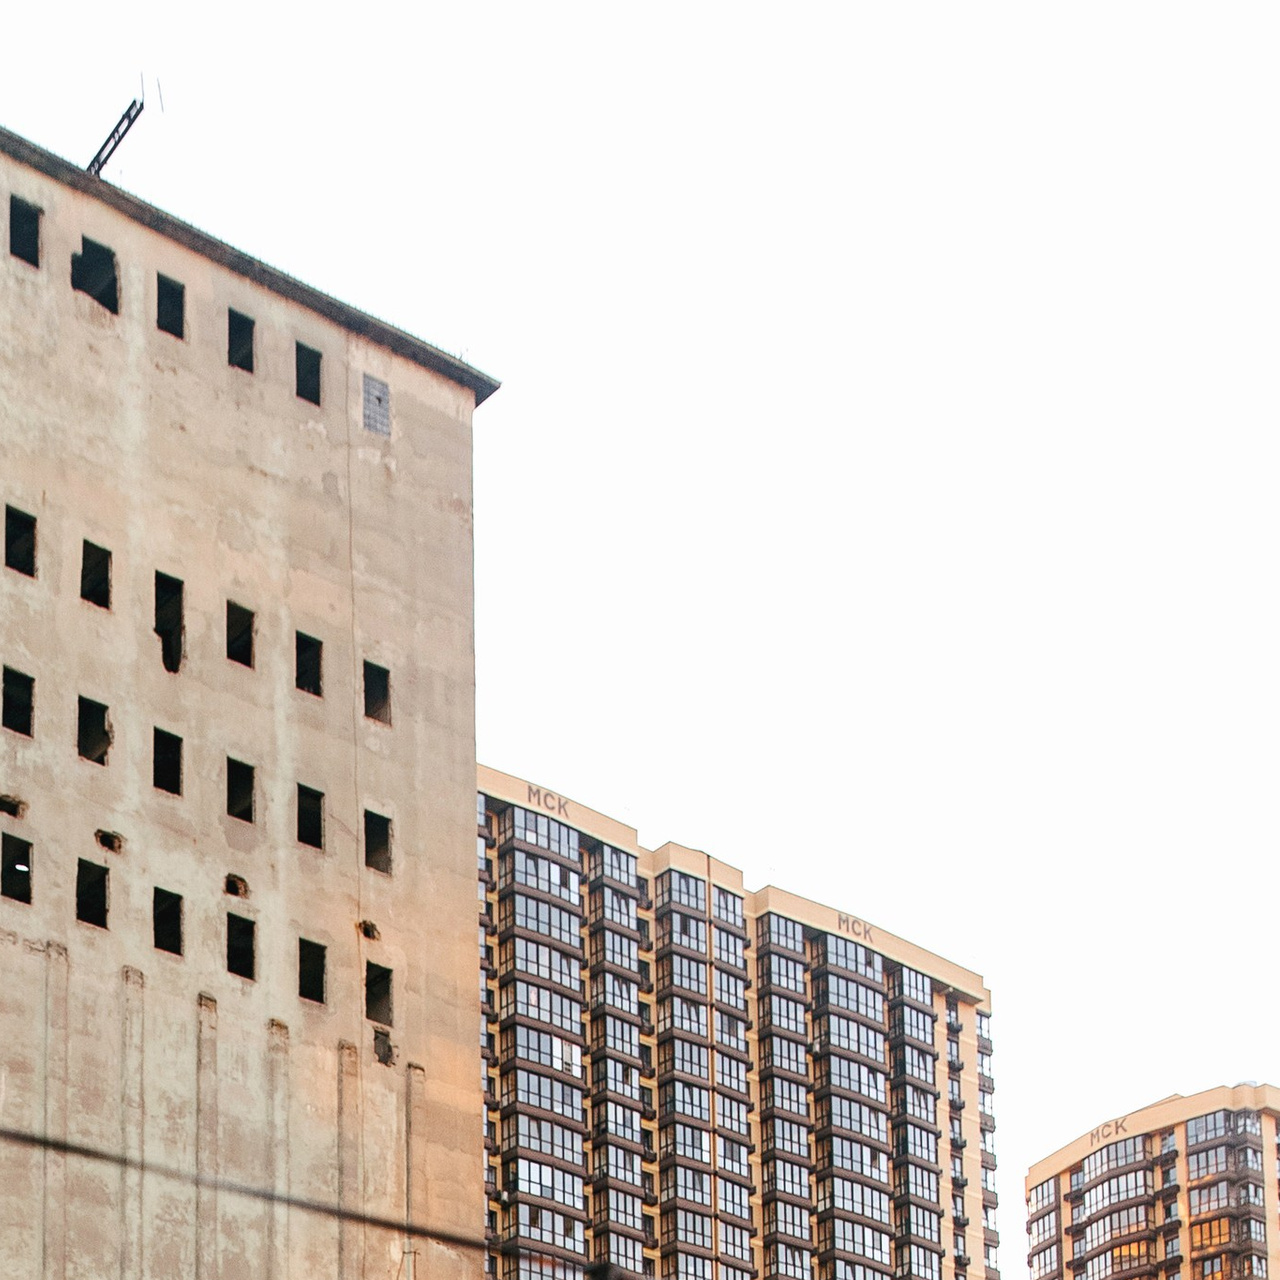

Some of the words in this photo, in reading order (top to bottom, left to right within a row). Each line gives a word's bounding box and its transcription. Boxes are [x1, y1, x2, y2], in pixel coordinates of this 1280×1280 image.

[526, 784, 569, 819] МСК
[837, 912, 874, 943] МСК
[1089, 1117, 1128, 1147] МСК
